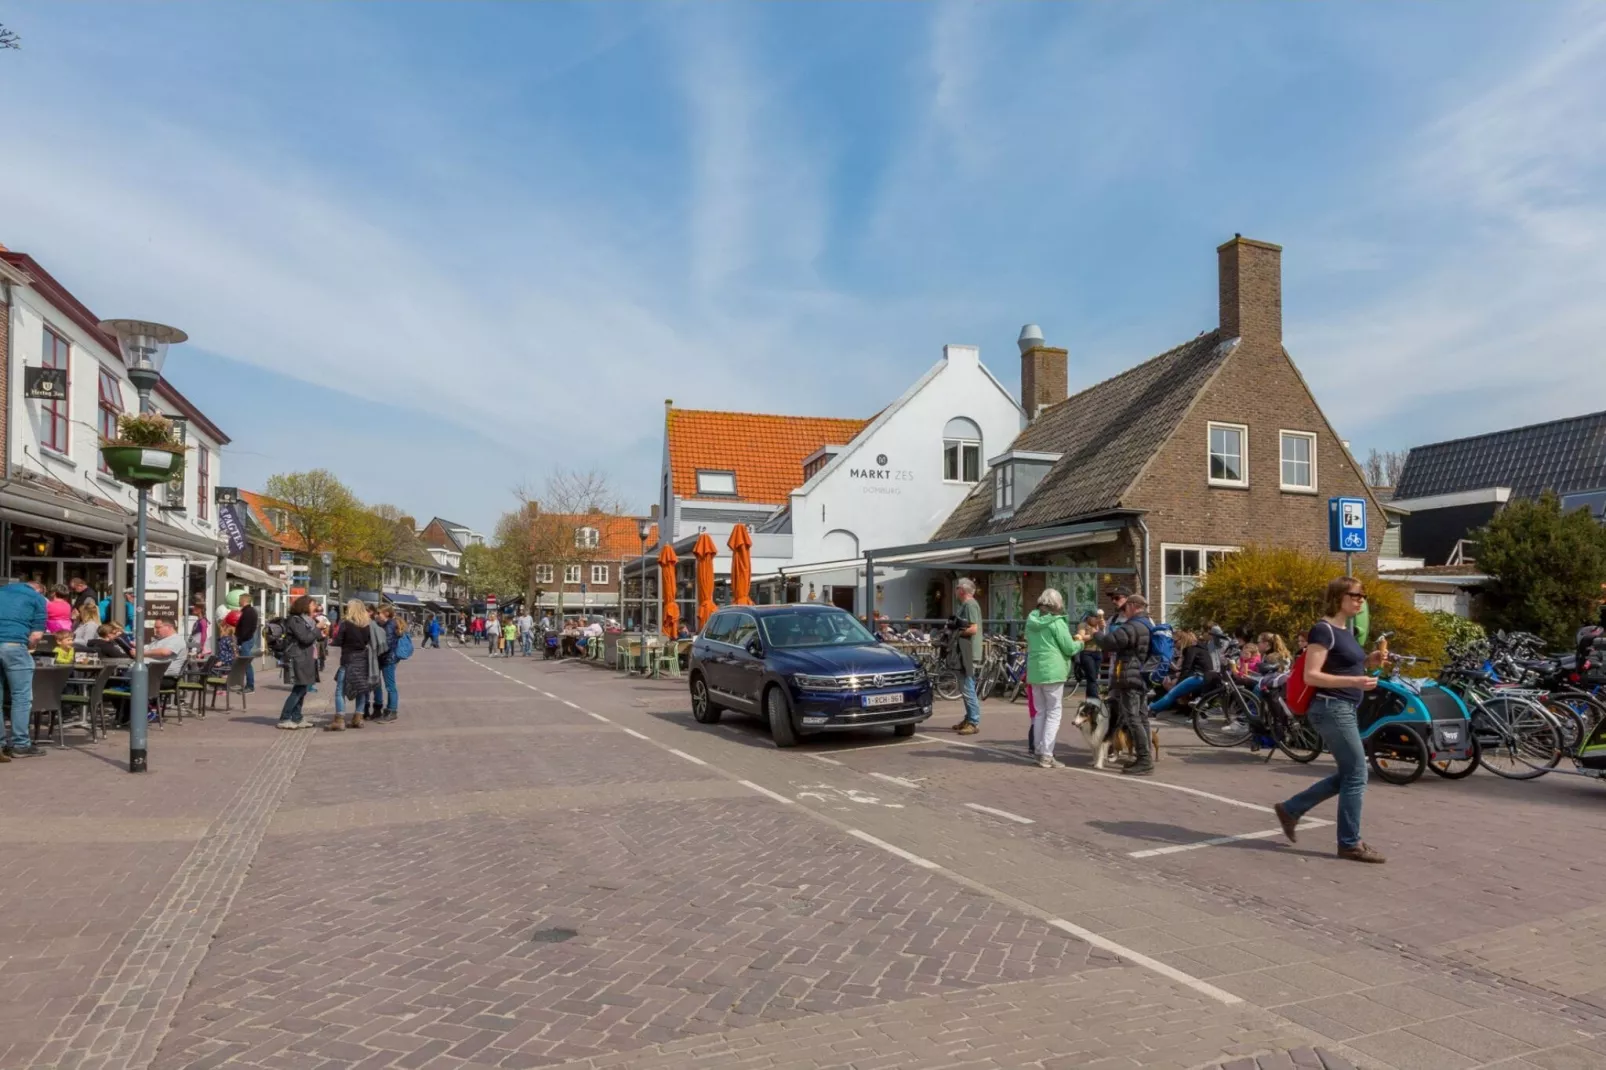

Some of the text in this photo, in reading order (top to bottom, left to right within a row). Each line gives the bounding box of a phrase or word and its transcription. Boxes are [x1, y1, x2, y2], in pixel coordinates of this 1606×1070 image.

[850, 468, 914, 481] MARKT ZES
[862, 486, 901, 495] DOMBURG
